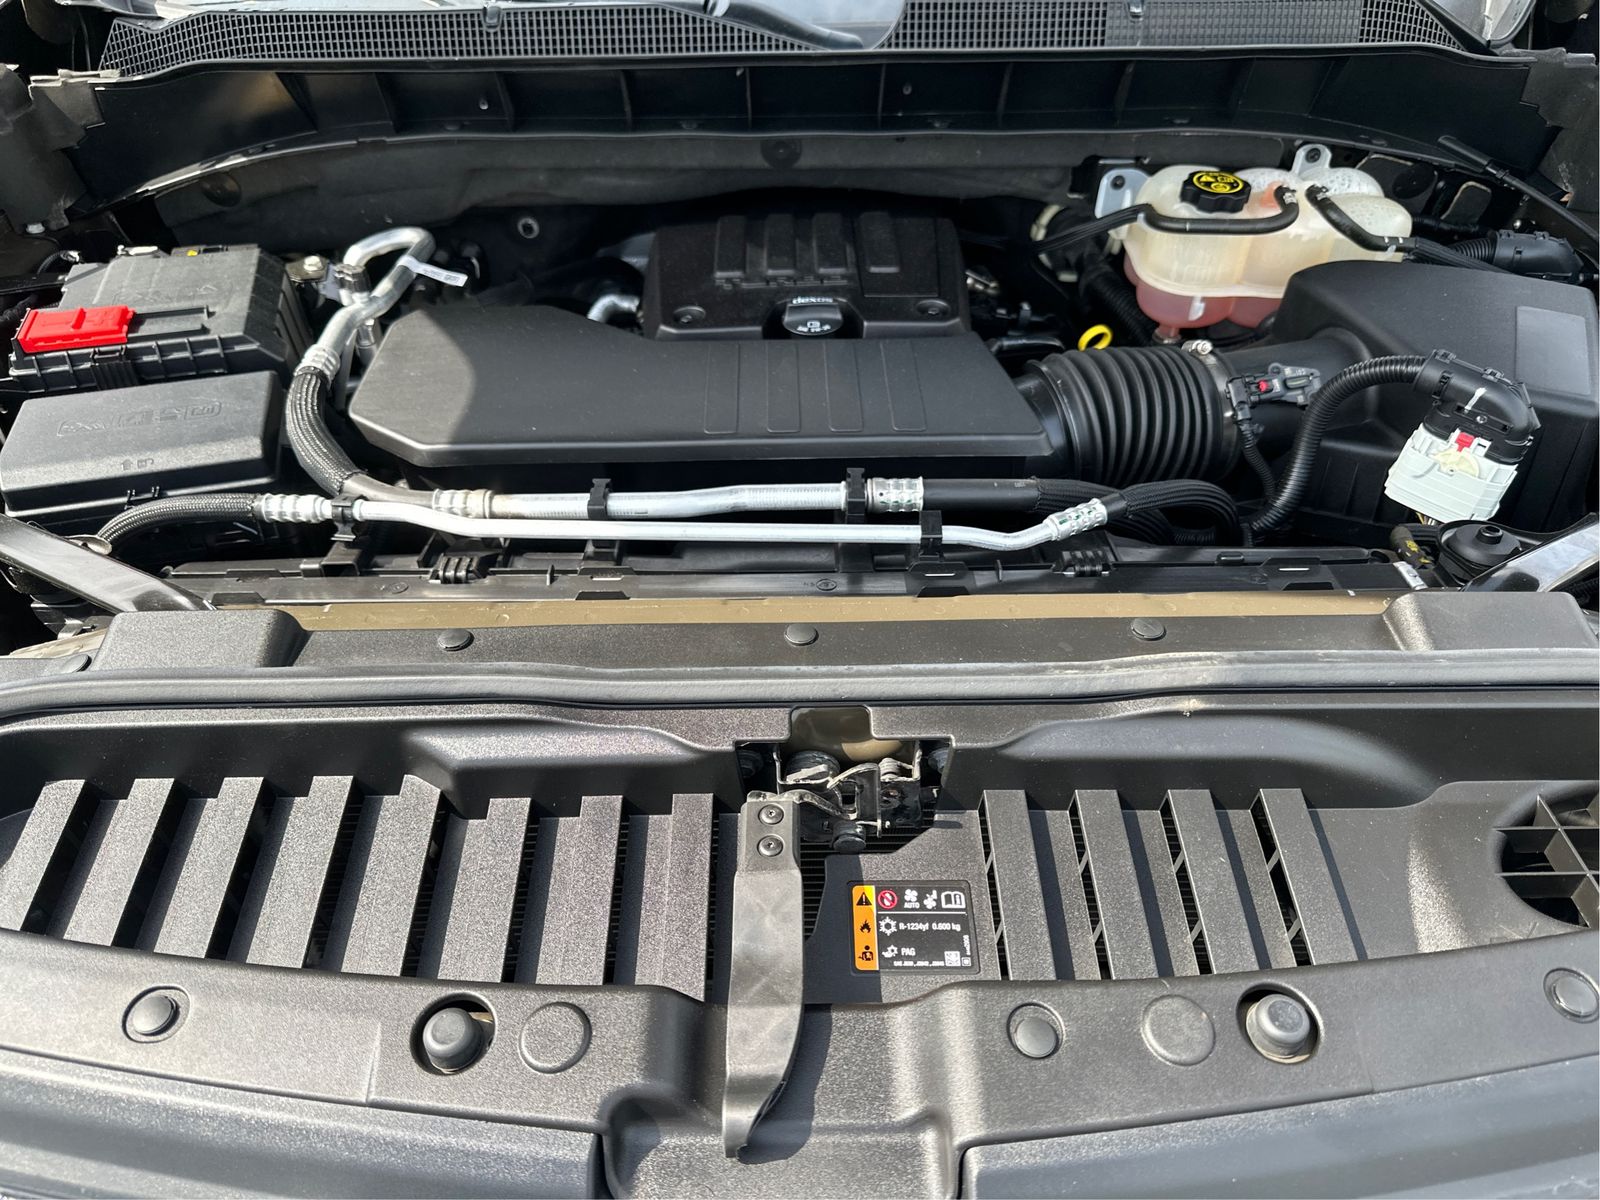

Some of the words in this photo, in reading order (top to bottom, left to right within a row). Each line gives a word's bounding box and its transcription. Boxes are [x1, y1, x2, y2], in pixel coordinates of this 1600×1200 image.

[792, 296, 833, 304] dexos
[898, 922, 929, 932] R-1234yf
[952, 922, 961, 932] kg
[901, 947, 916, 956] PAG
